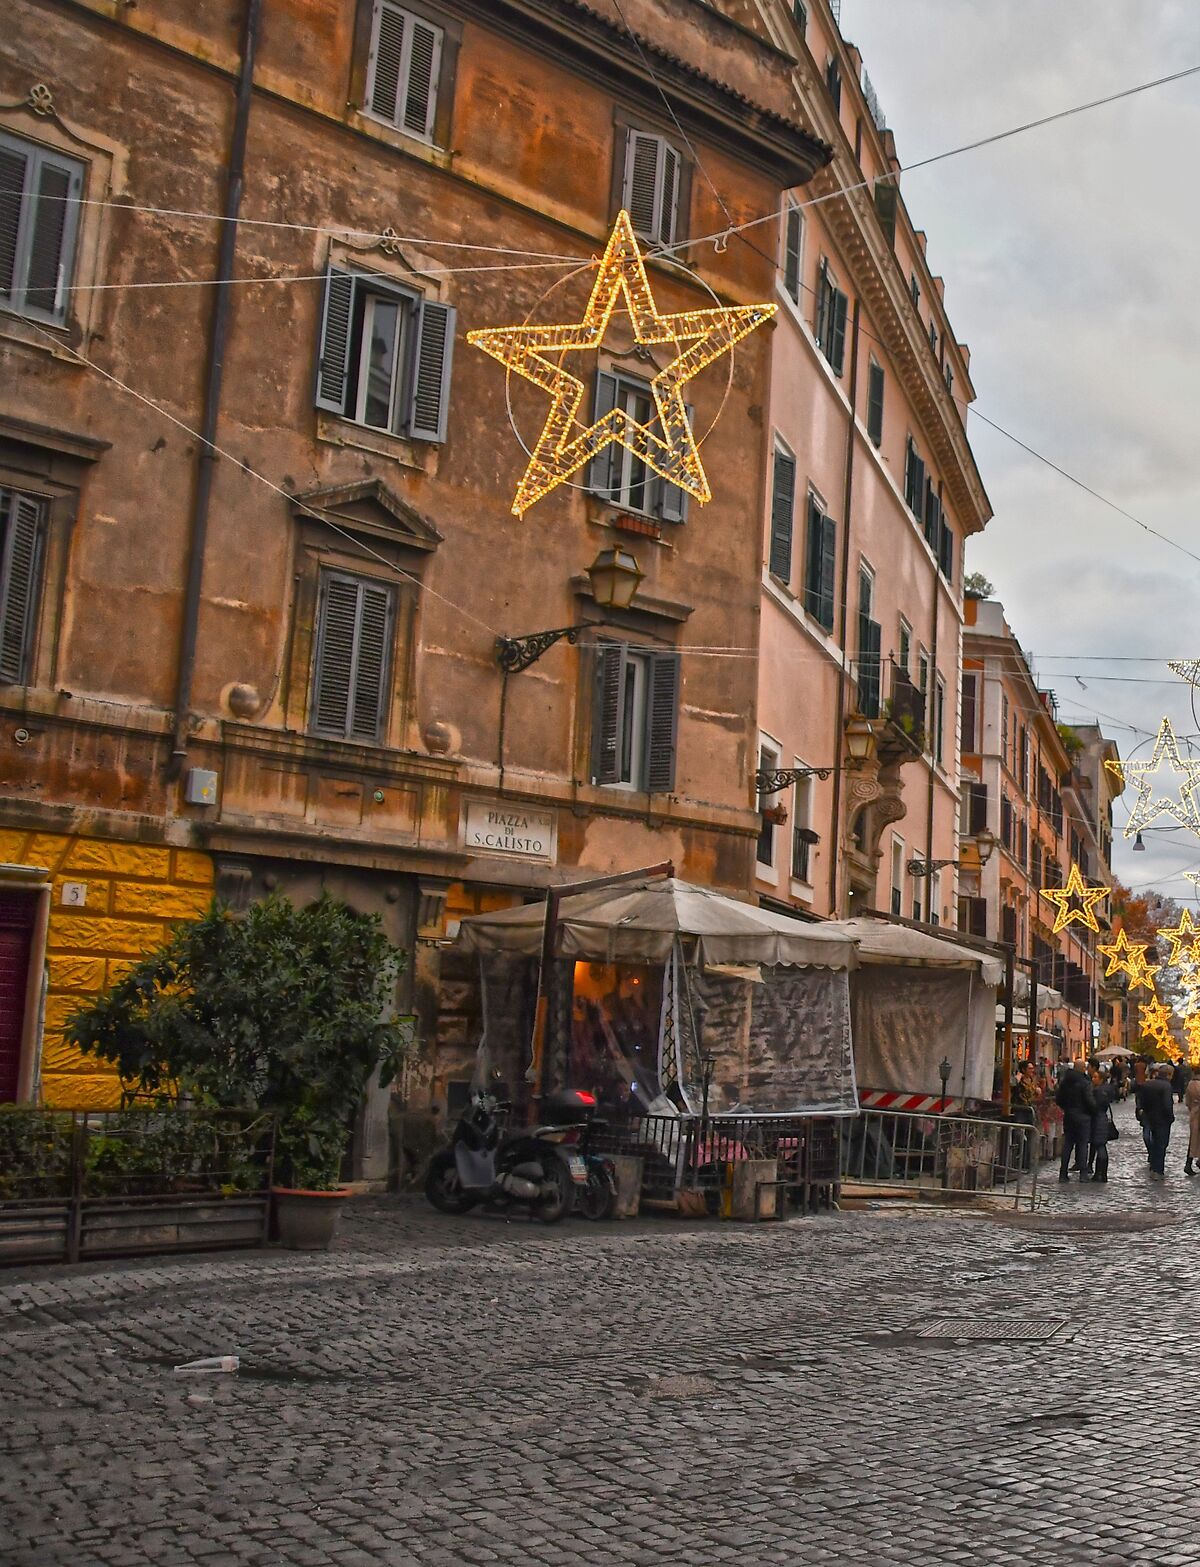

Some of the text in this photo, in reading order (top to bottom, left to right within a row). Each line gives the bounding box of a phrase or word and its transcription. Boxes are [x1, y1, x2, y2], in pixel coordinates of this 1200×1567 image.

[488, 812, 528, 829] PIAZZA
[504, 827, 514, 836] DI
[474, 833, 542, 852] S.CALISTO
[71, 887, 79, 902] 5
